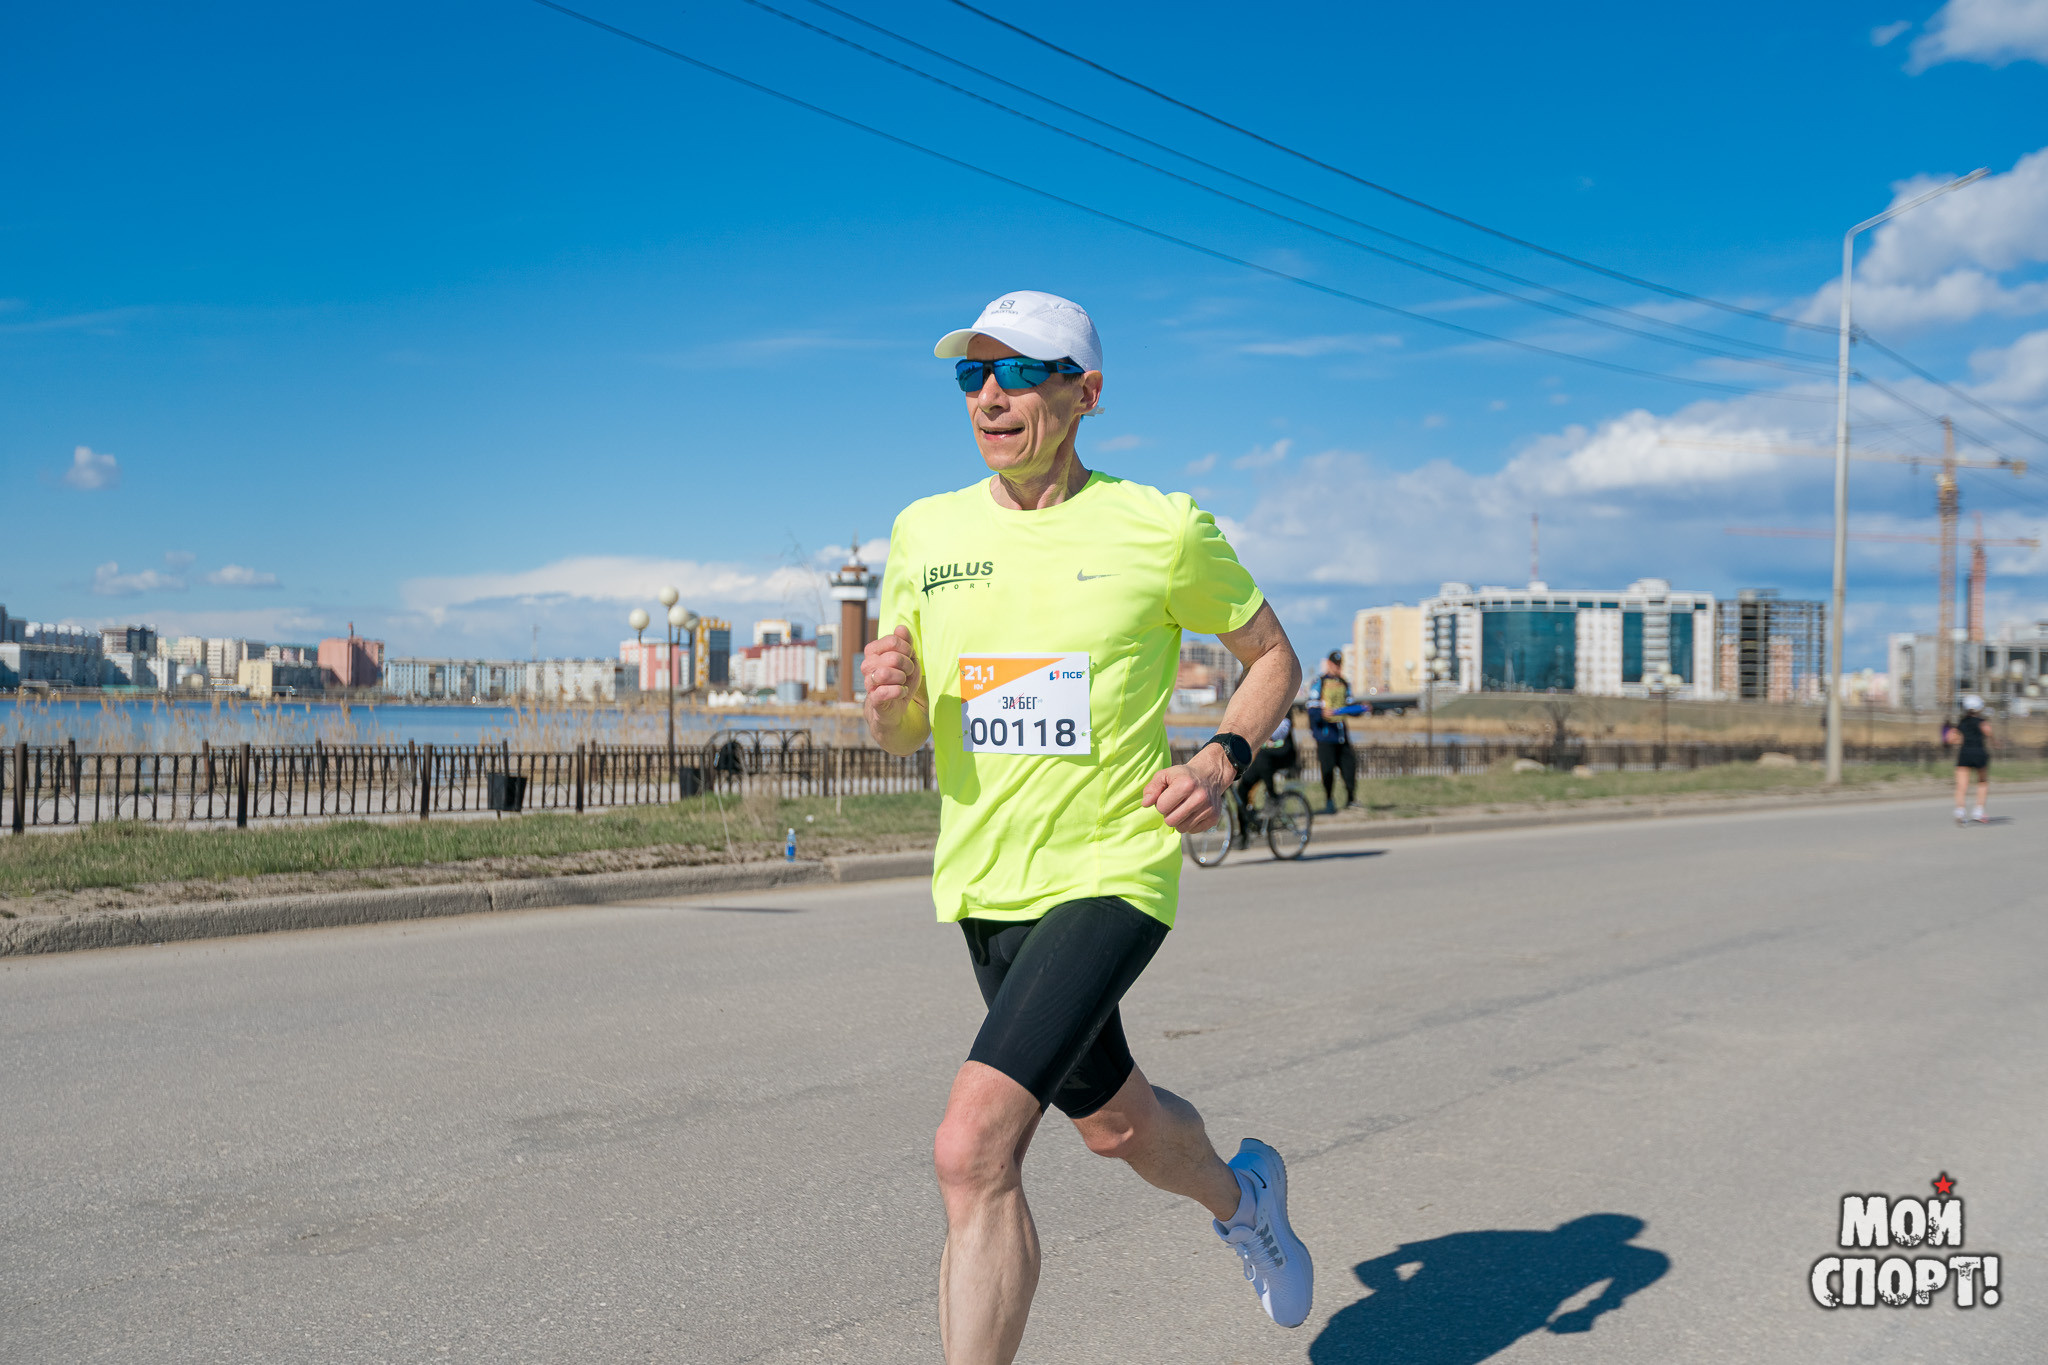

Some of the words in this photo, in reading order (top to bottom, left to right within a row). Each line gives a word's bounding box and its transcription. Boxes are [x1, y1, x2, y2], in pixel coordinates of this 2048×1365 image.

[929, 561, 994, 582] SULUS
[930, 582, 991, 596] SPORT
[965, 665, 994, 683] 21,1
[1062, 671, 1083, 679] ПСБ
[970, 717, 1076, 747] 00118
